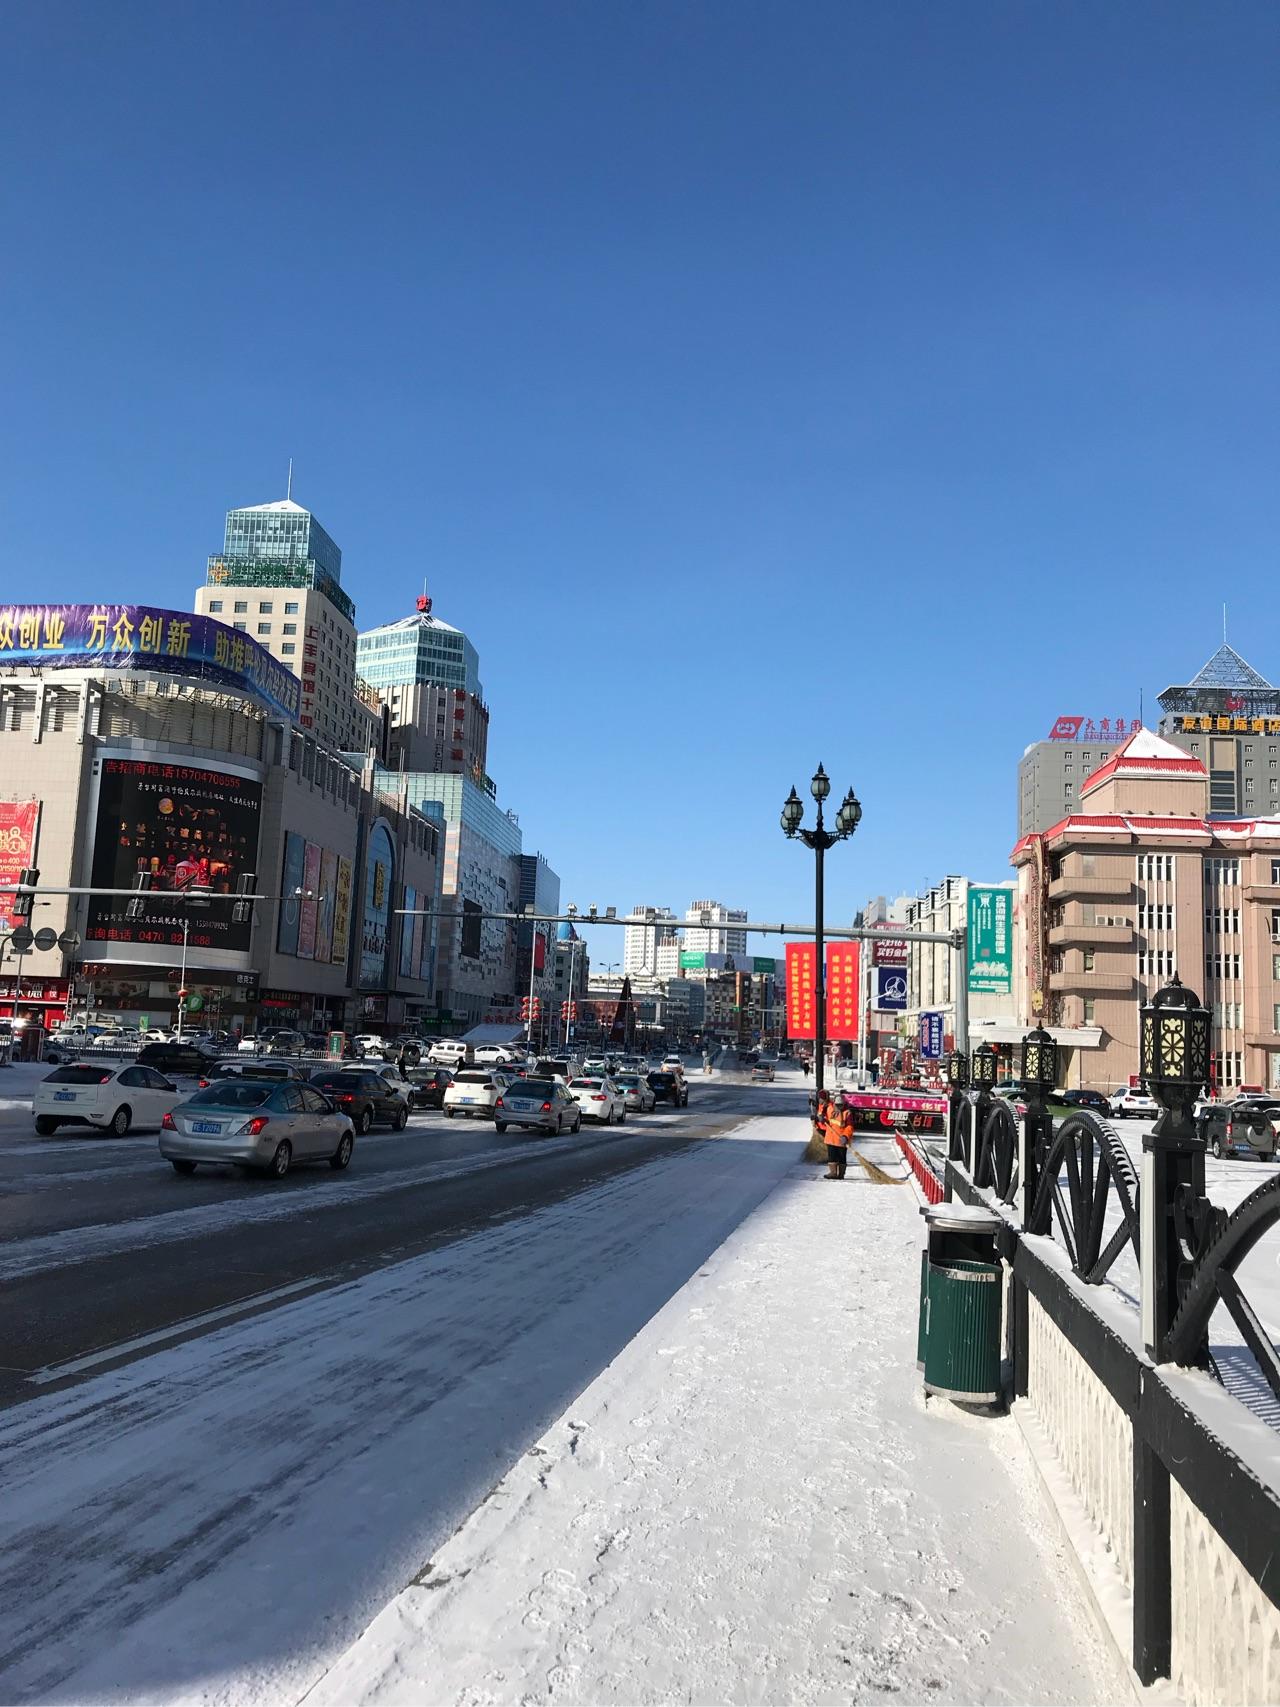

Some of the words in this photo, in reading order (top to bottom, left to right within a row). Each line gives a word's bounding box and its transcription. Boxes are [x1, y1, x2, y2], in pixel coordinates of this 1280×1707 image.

[86, 612, 192, 657] 万众创新
[1085, 717, 1141, 732] 大商集团
[138, 930, 165, 943] 0470
[170, 932, 212, 946] 821588
